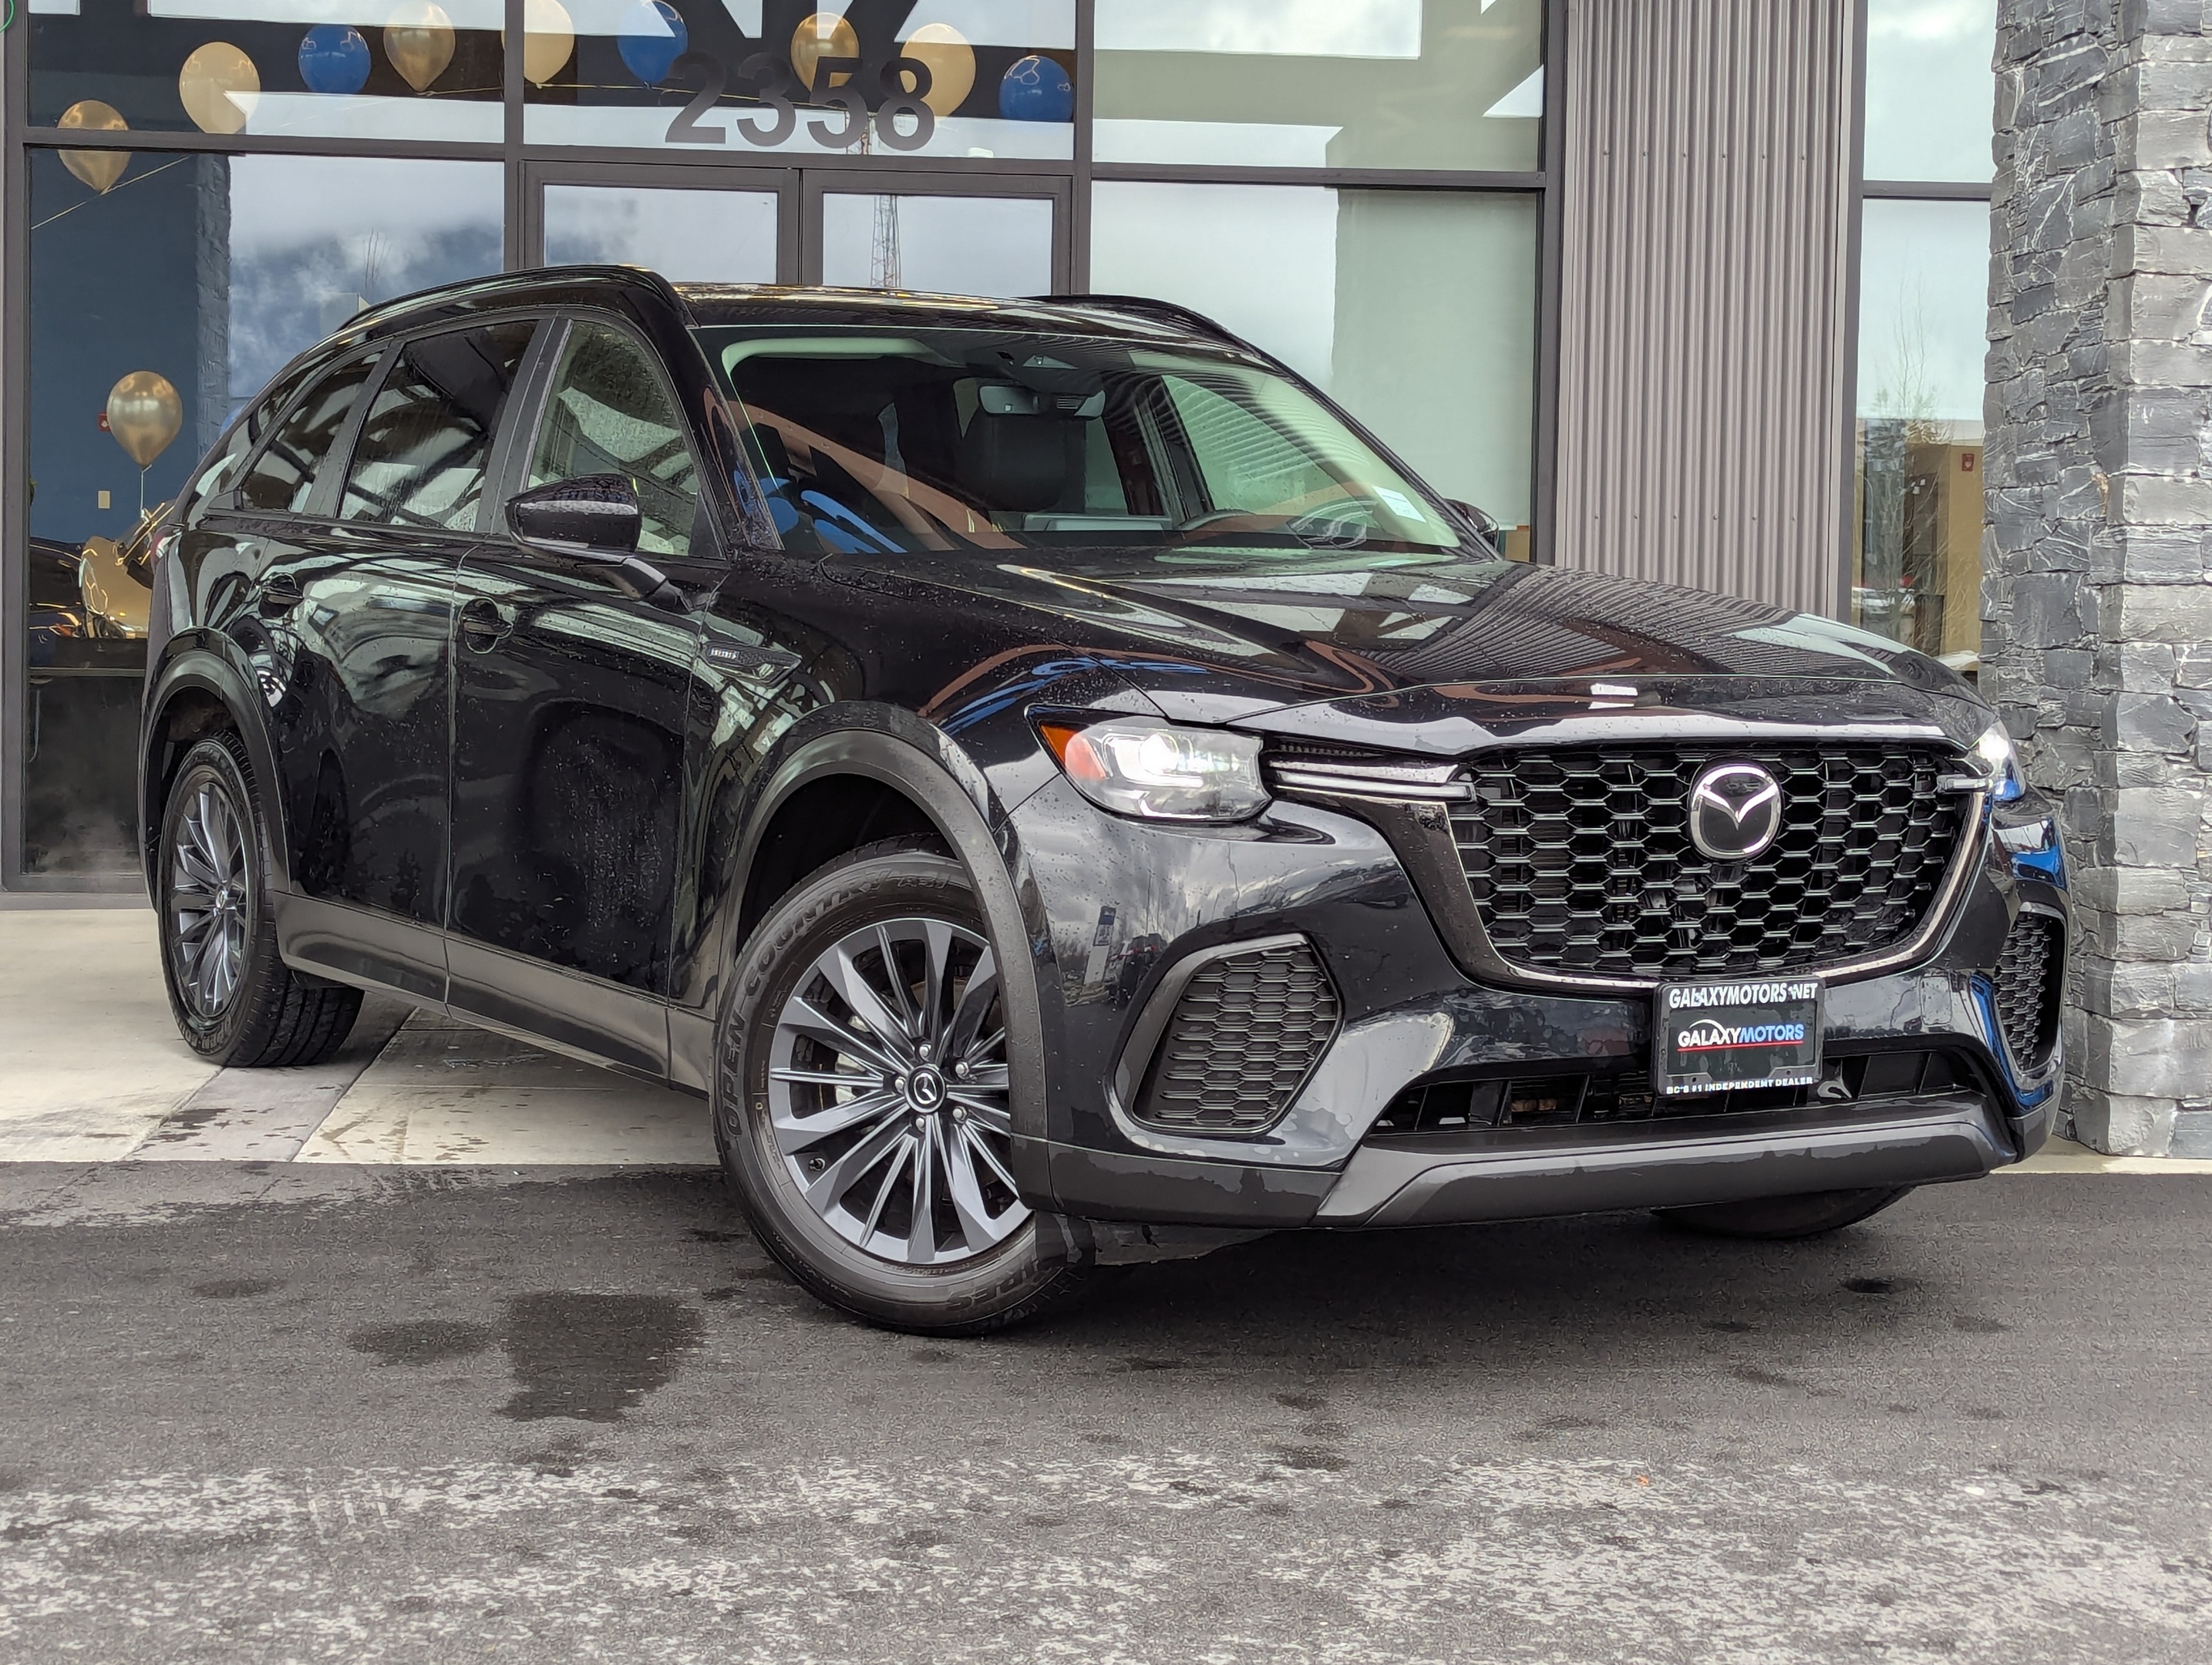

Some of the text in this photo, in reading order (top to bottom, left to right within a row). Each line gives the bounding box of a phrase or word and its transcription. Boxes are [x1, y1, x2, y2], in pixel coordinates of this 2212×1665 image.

[665, 51, 935, 151] 2358
[1705, 1079, 1774, 1092] INDEPENDENT
[1776, 1077, 1813, 1087] DEALER
